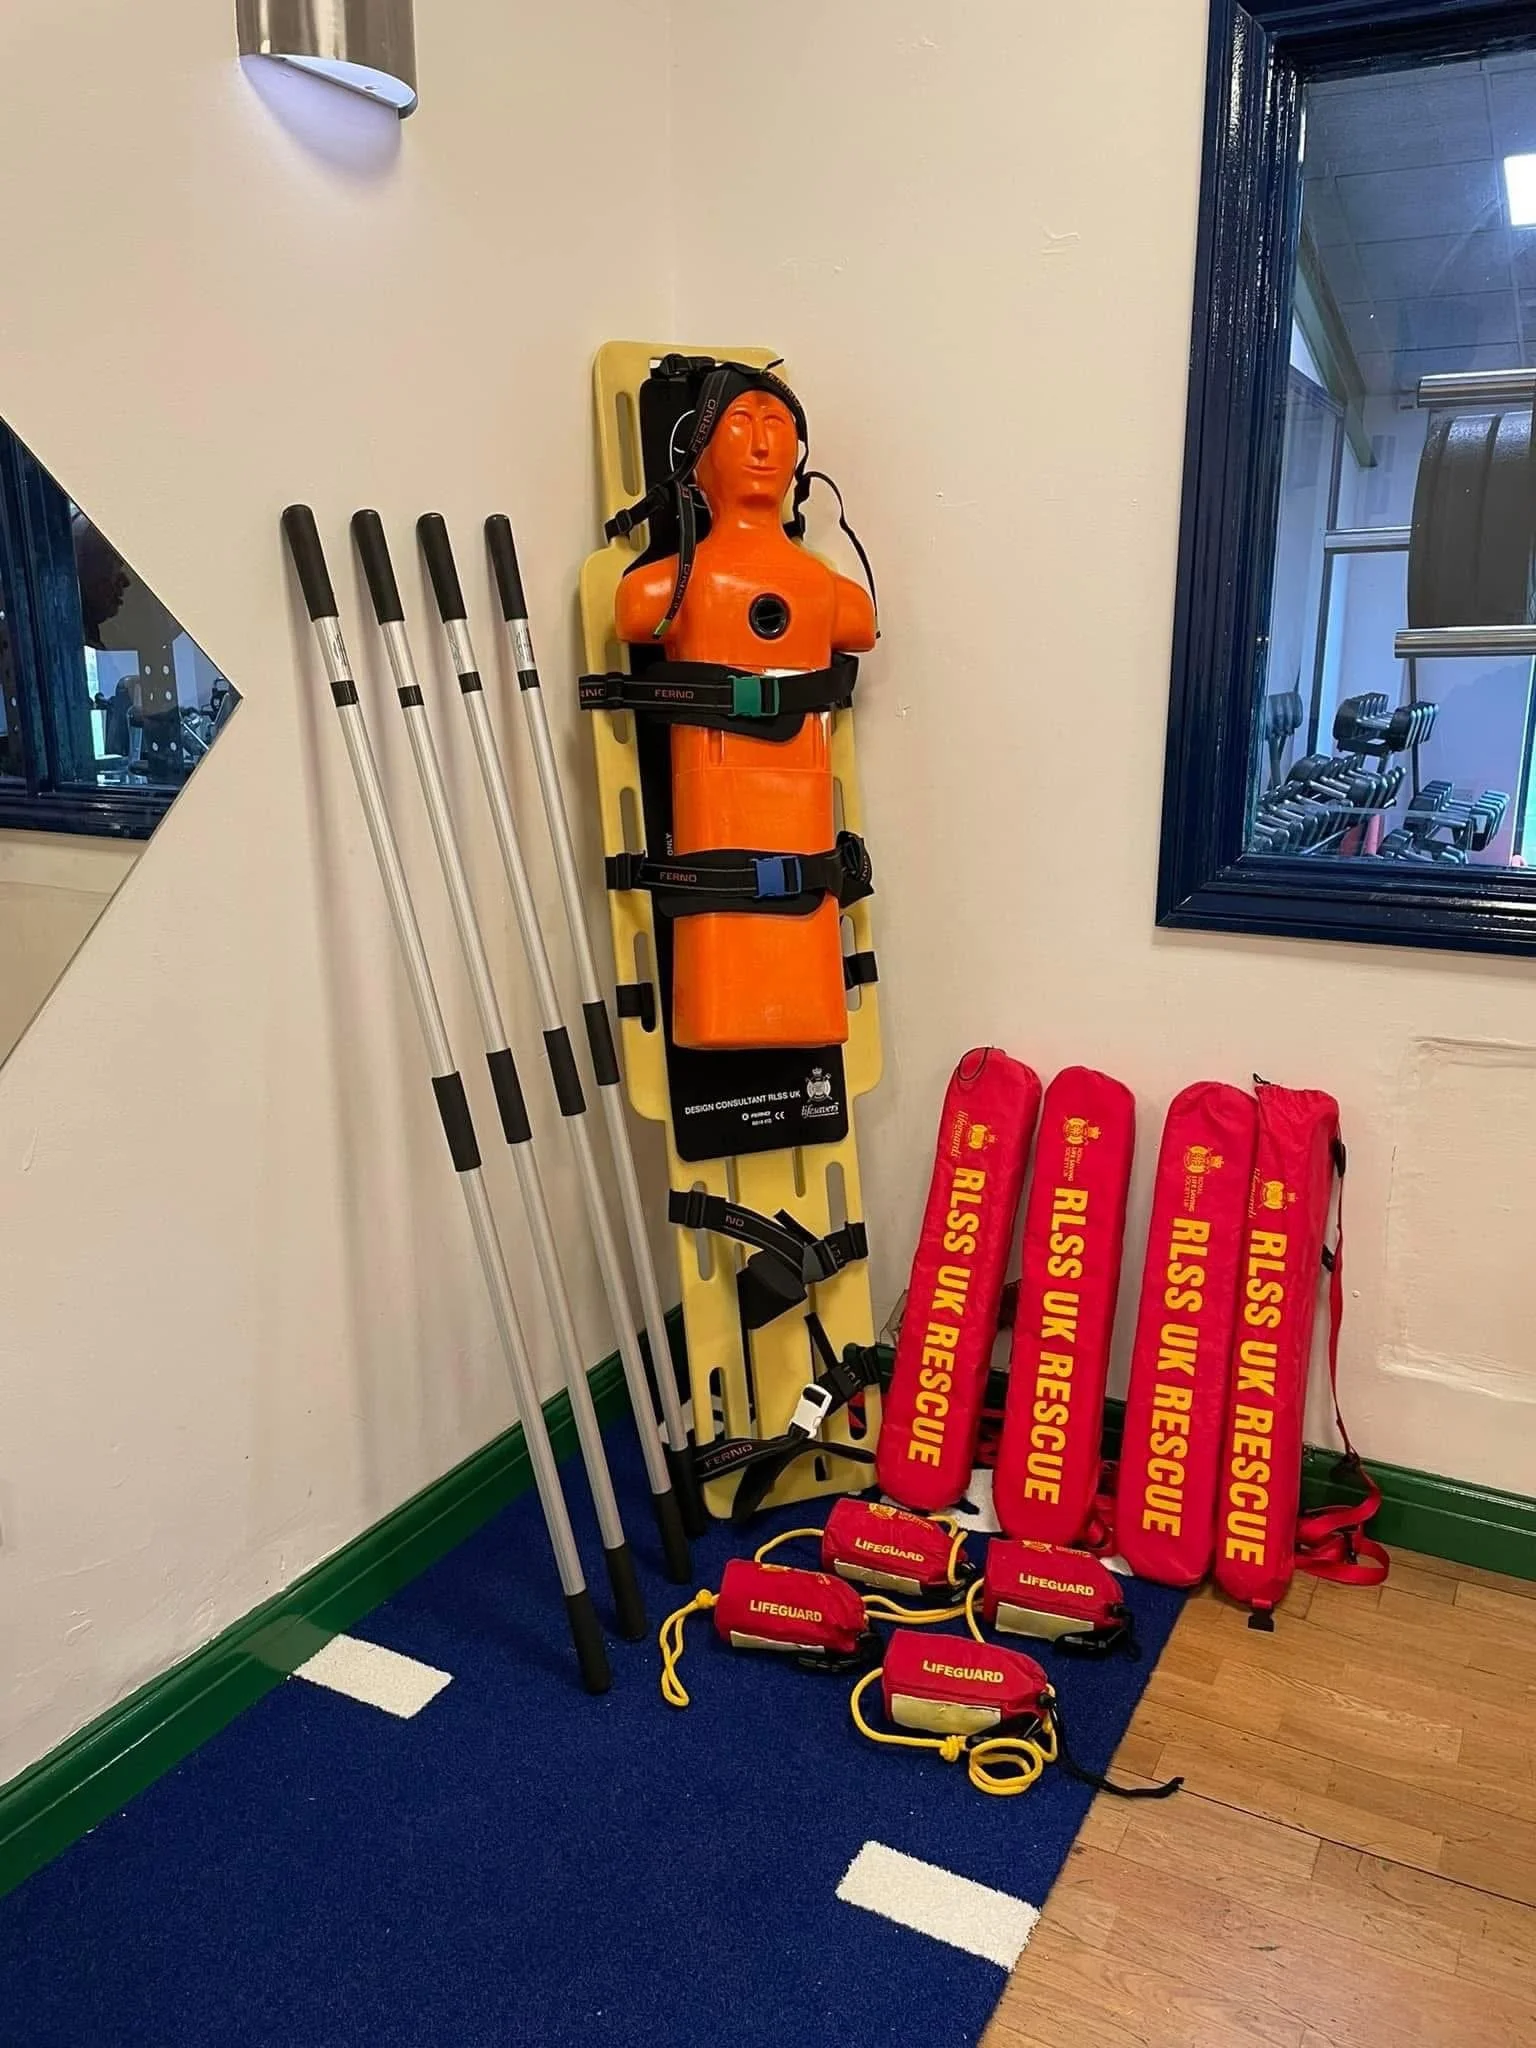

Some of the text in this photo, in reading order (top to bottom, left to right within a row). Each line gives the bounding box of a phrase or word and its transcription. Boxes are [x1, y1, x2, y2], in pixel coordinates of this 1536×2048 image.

[692, 399, 717, 453] FERNO
[654, 688, 695, 699] FERNO
[665, 832, 673, 856] ONLY
[660, 871, 697, 883] FERNO
[684, 1089, 801, 1115] DESIGN CONSULTANT RLSS UK
[951, 1110, 969, 1157] lifeguards
[944, 1168, 986, 1255] RLSS
[1047, 1188, 1089, 1279] RLSS
[932, 1265, 971, 1315] UK
[1041, 1292, 1079, 1343] UK
[908, 1323, 960, 1467] RESCUE
[1142, 1218, 1210, 1537] RLSS UK RESCUE
[1225, 1230, 1287, 1566] RLSS UK RESCUE
[1024, 1352, 1074, 1505] RESCUE
[704, 1443, 753, 1468] FERNO
[854, 1537, 925, 1562] LIFEGUARD
[1019, 1572, 1095, 1596] LIFEGUARD
[749, 1599, 823, 1622] LIFEGUARD
[922, 1660, 1005, 1683] LIFEGUARD
